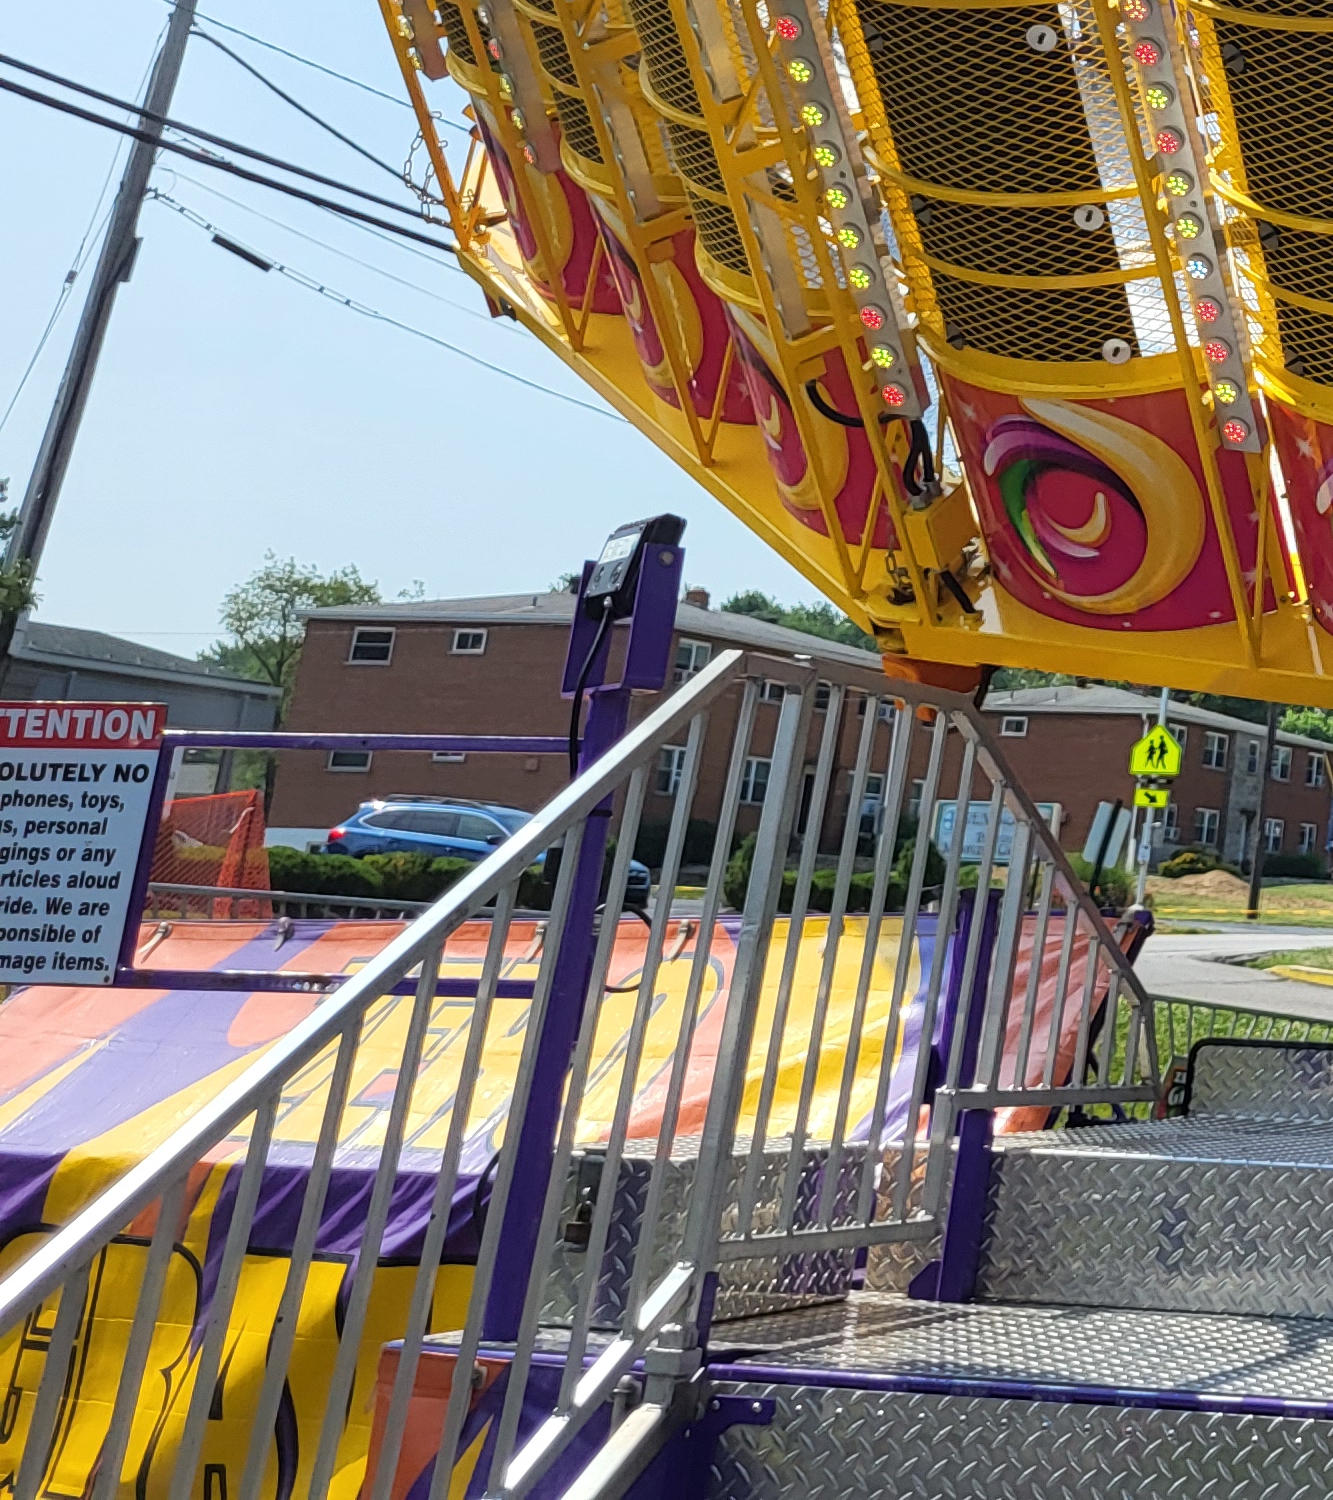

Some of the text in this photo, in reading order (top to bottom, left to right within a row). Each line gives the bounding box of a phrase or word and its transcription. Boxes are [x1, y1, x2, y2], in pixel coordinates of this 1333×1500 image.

[0, 708, 156, 741] TENTION
[113, 764, 150, 784] NO
[0, 789, 125, 813] phones, toys,
[23, 817, 108, 839] personal
[56, 845, 76, 863] or
[81, 845, 117, 867] any
[66, 871, 121, 890] aloud
[45, 896, 75, 917] We
[78, 901, 111, 918] are
[81, 924, 102, 944] of
[51, 950, 110, 972] items.
